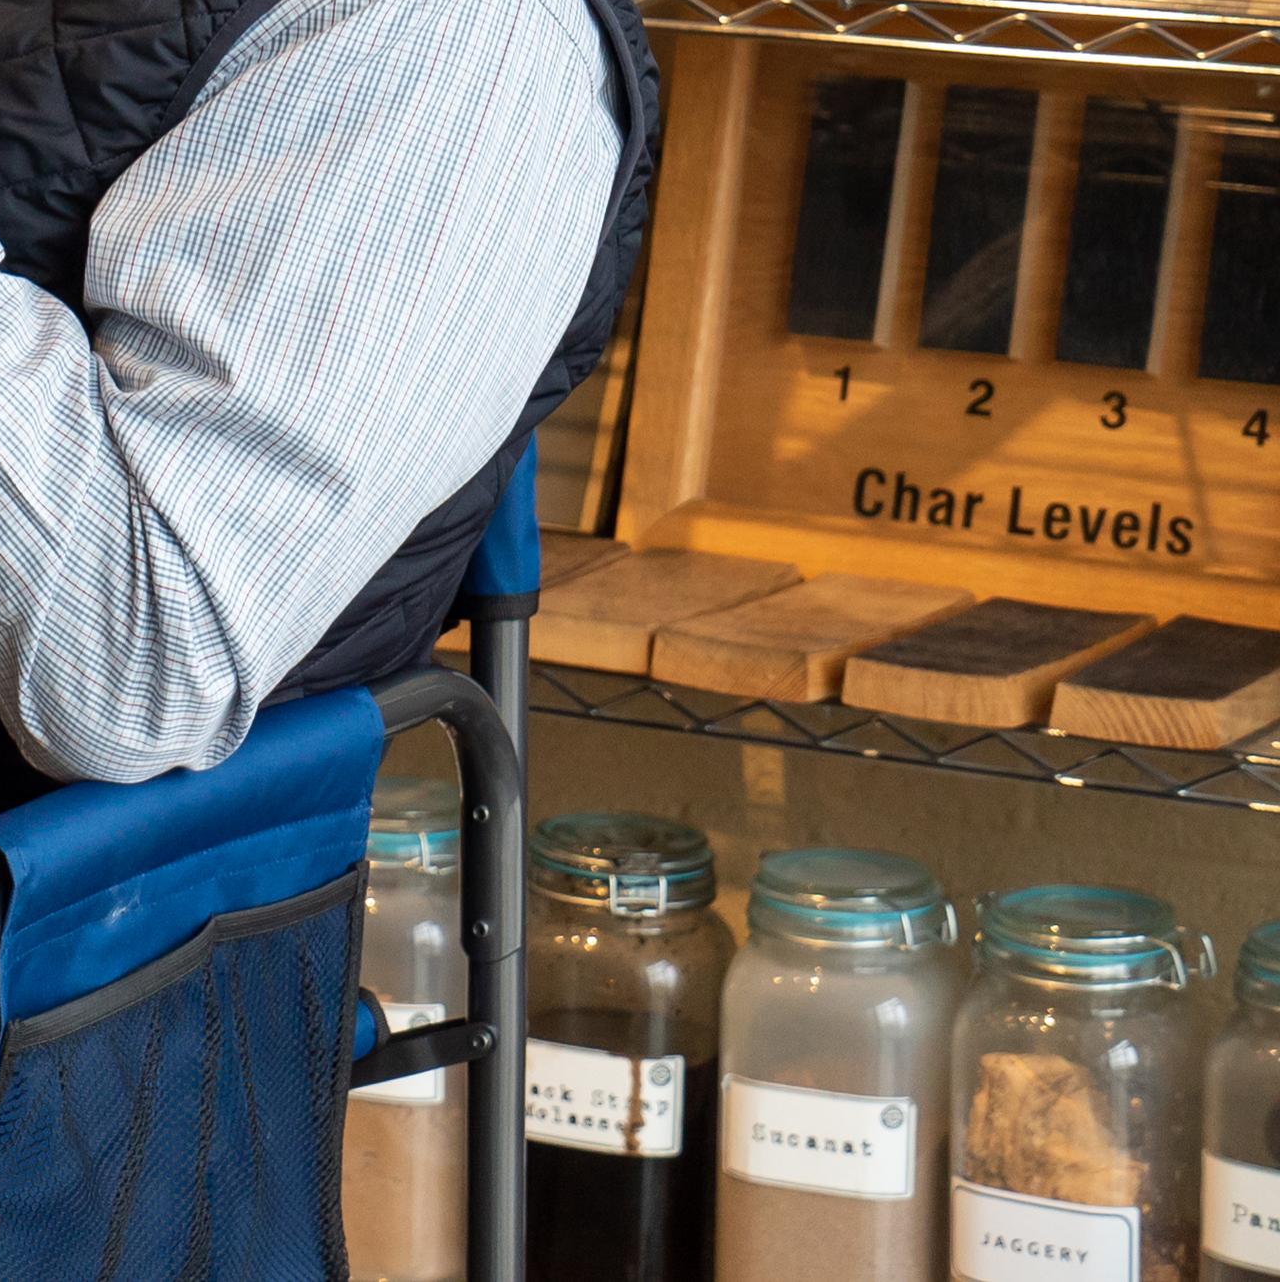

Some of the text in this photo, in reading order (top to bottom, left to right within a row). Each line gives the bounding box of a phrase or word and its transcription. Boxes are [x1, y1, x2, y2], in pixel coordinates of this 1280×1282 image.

[834, 365, 1271, 447] 1 2 3 4
[852, 466, 1195, 556] Char Levels
[530, 1084, 669, 1117] ack Stap
[752, 1122, 873, 1157] Sucanat
[980, 1232, 1089, 1264] JAGGERY
